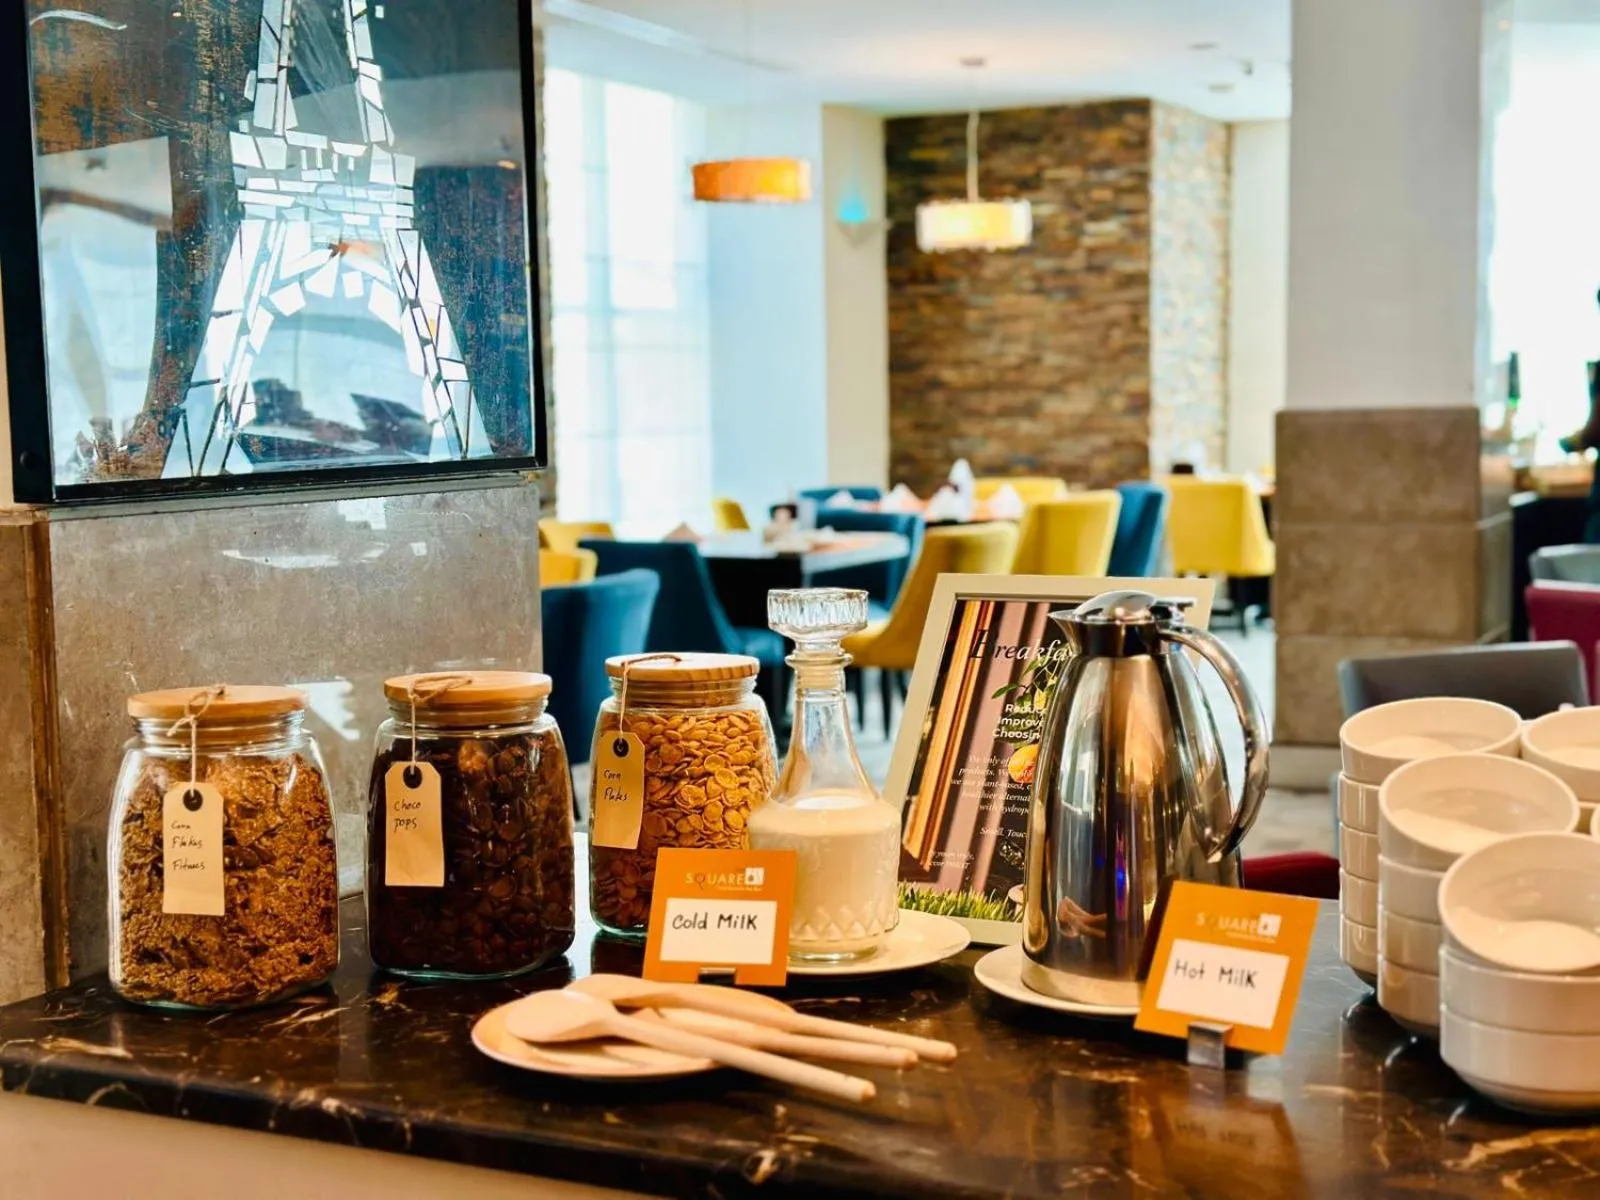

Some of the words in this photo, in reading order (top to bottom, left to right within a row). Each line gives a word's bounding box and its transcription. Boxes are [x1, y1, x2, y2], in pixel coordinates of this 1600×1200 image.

[968, 628, 1068, 667] Breakfa
[1004, 703, 1045, 716] Reduc
[997, 716, 1043, 730] Improv
[991, 727, 1040, 740] Choosin
[393, 798, 421, 812] Choco
[672, 911, 708, 930] Cold
[1173, 958, 1205, 980] Hot
